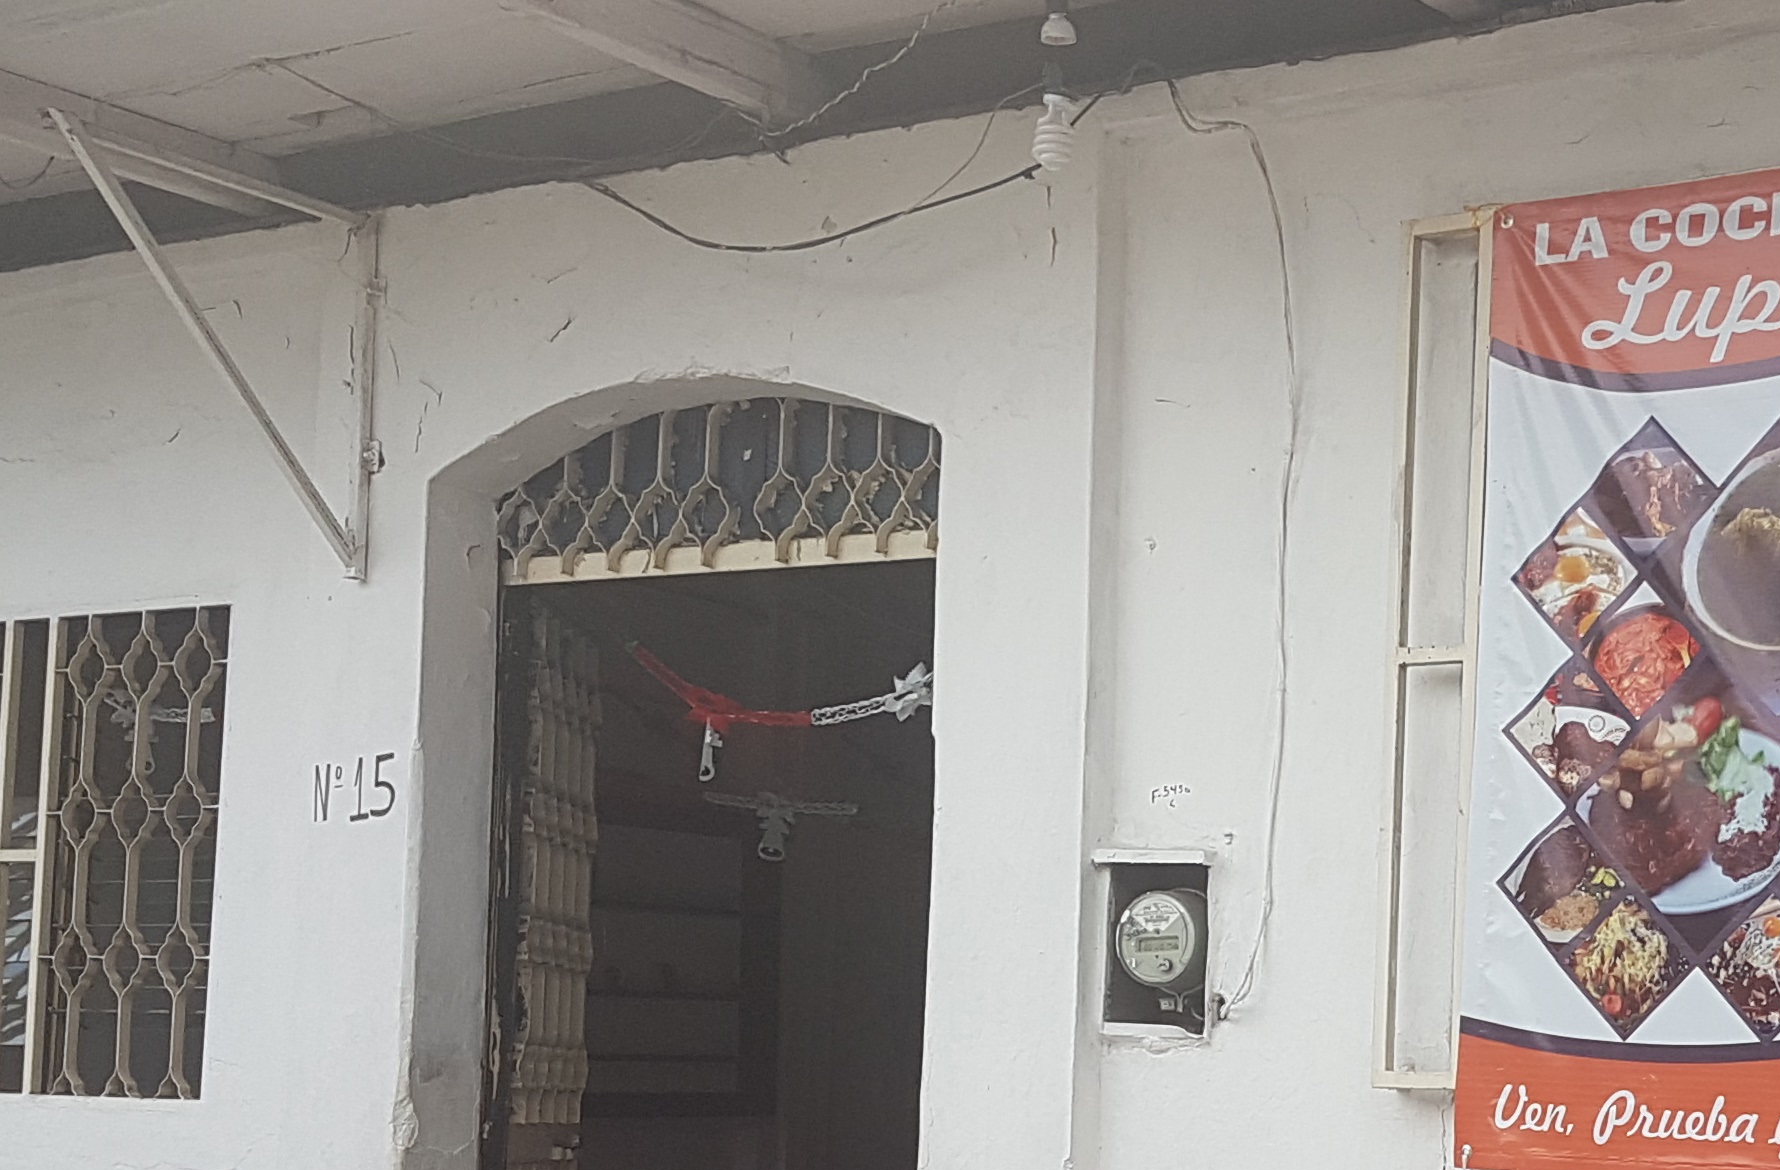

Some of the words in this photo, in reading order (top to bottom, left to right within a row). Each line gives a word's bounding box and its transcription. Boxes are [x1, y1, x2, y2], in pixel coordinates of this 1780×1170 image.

[1535, 217, 1609, 265] LA
[350, 752, 396, 822] 15
[1493, 1083, 1574, 1137] Ven,
[1593, 1089, 1756, 1146] Prueba
